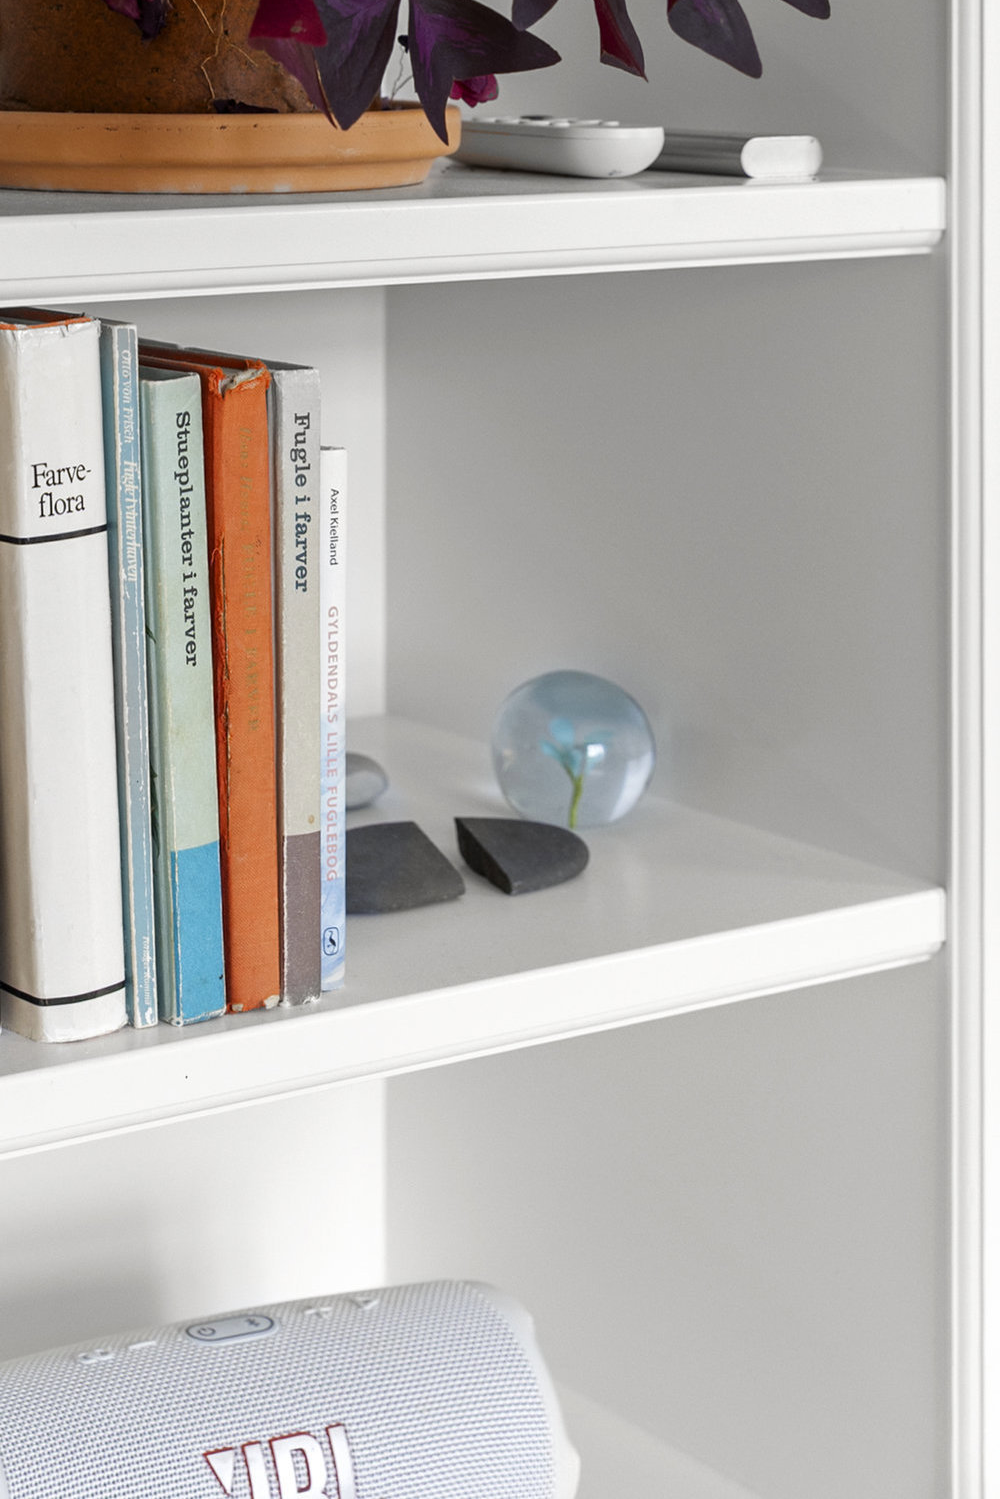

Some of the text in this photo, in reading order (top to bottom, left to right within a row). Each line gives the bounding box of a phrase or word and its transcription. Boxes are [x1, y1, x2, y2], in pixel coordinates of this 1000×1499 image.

[31, 460, 92, 490] Farve-
[38, 491, 86, 518] flora
[174, 411, 198, 667] Stueplanter i farver
[290, 412, 311, 593] Fugle i farver
[329, 488, 339, 566] Axel Kielland
[326, 606, 339, 882] GYLDENDALS LILLE FUGLEBOG
